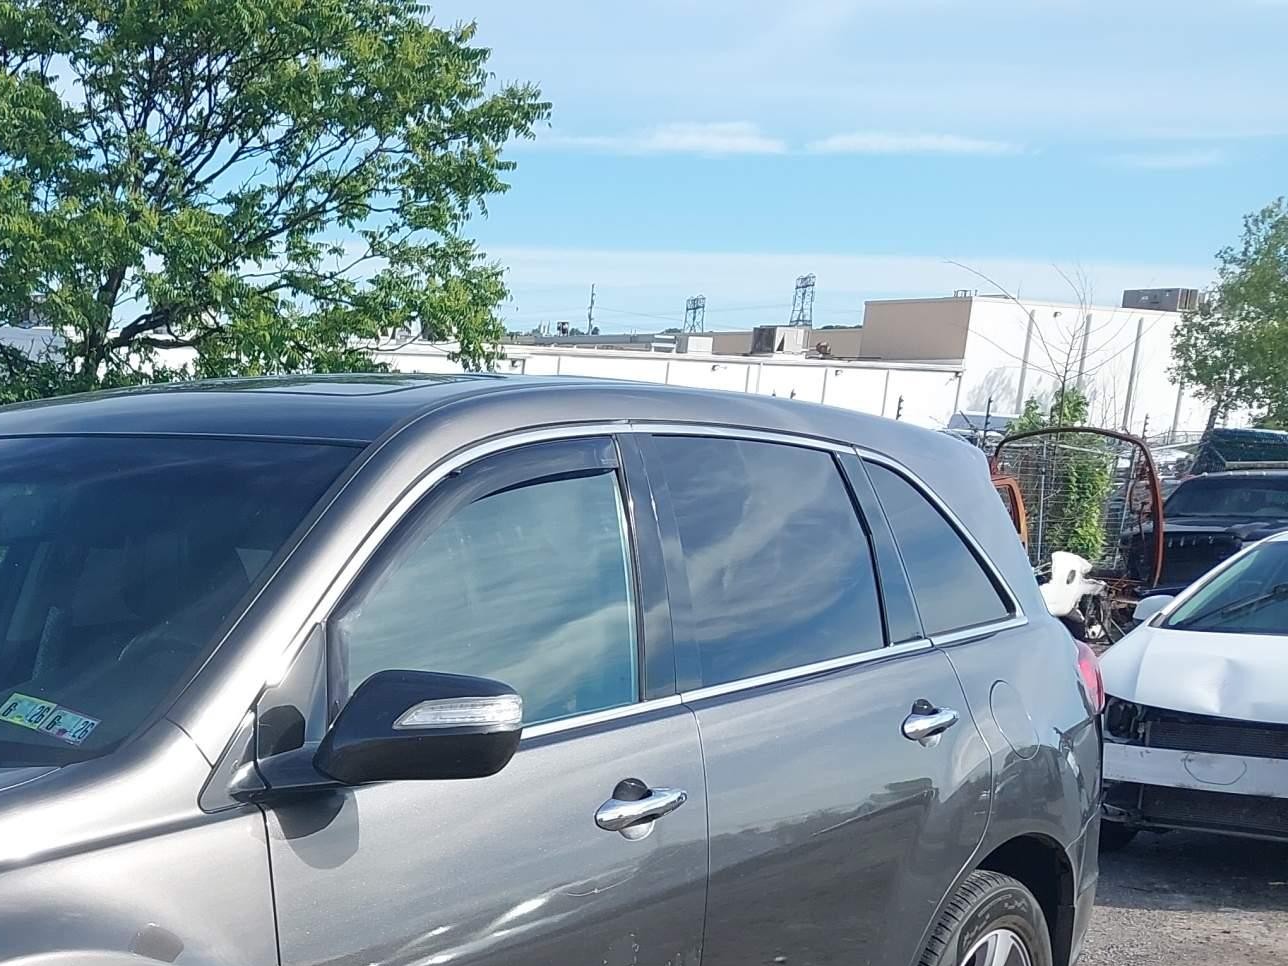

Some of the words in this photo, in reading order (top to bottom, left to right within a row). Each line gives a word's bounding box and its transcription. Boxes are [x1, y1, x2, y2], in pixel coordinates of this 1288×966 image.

[2, 702, 18, 717] 6
[27, 705, 50, 724] 26
[46, 715, 62, 731] 6
[72, 720, 94, 740] 26
